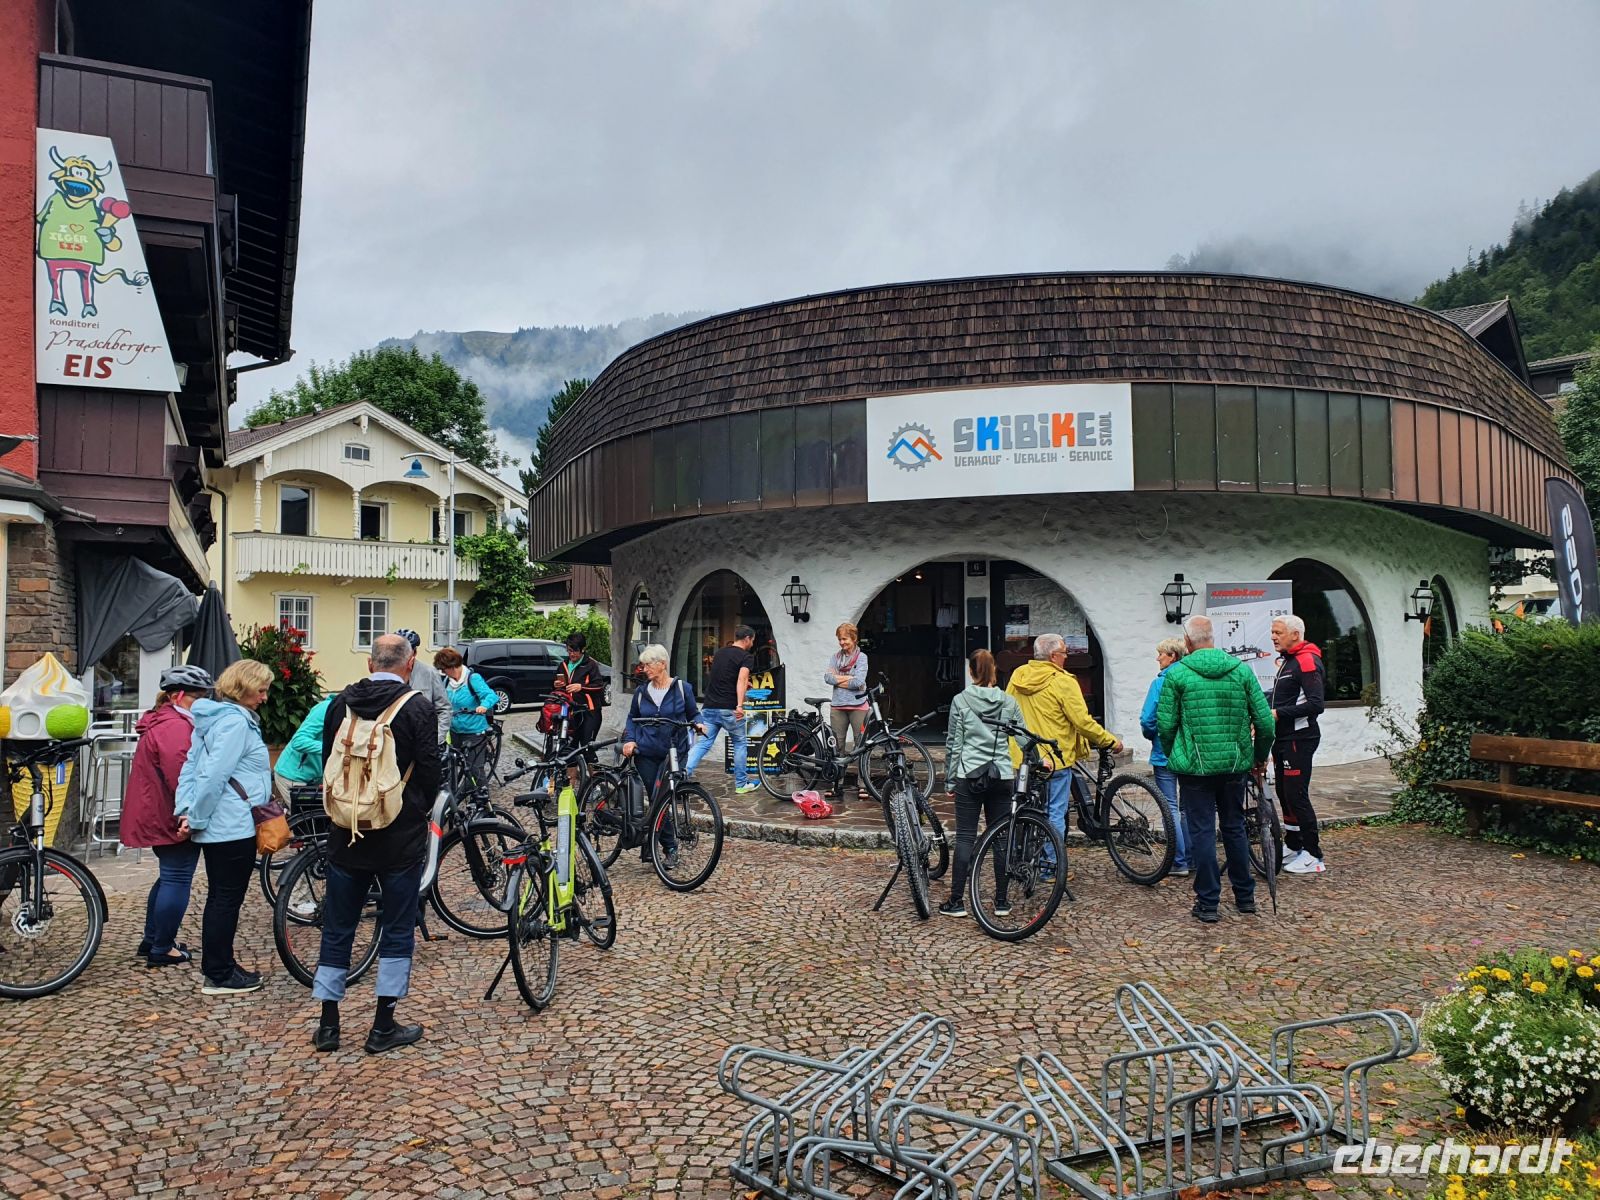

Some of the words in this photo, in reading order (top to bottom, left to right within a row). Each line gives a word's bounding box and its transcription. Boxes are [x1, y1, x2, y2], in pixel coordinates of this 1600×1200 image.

[59, 241, 83, 251] EIS
[49, 318, 100, 329] Konditorei
[45, 328, 163, 365] Praschberger
[63, 354, 114, 379] EIS
[1099, 411, 1113, 446] STADL
[1069, 450, 1113, 462] SERVICE
